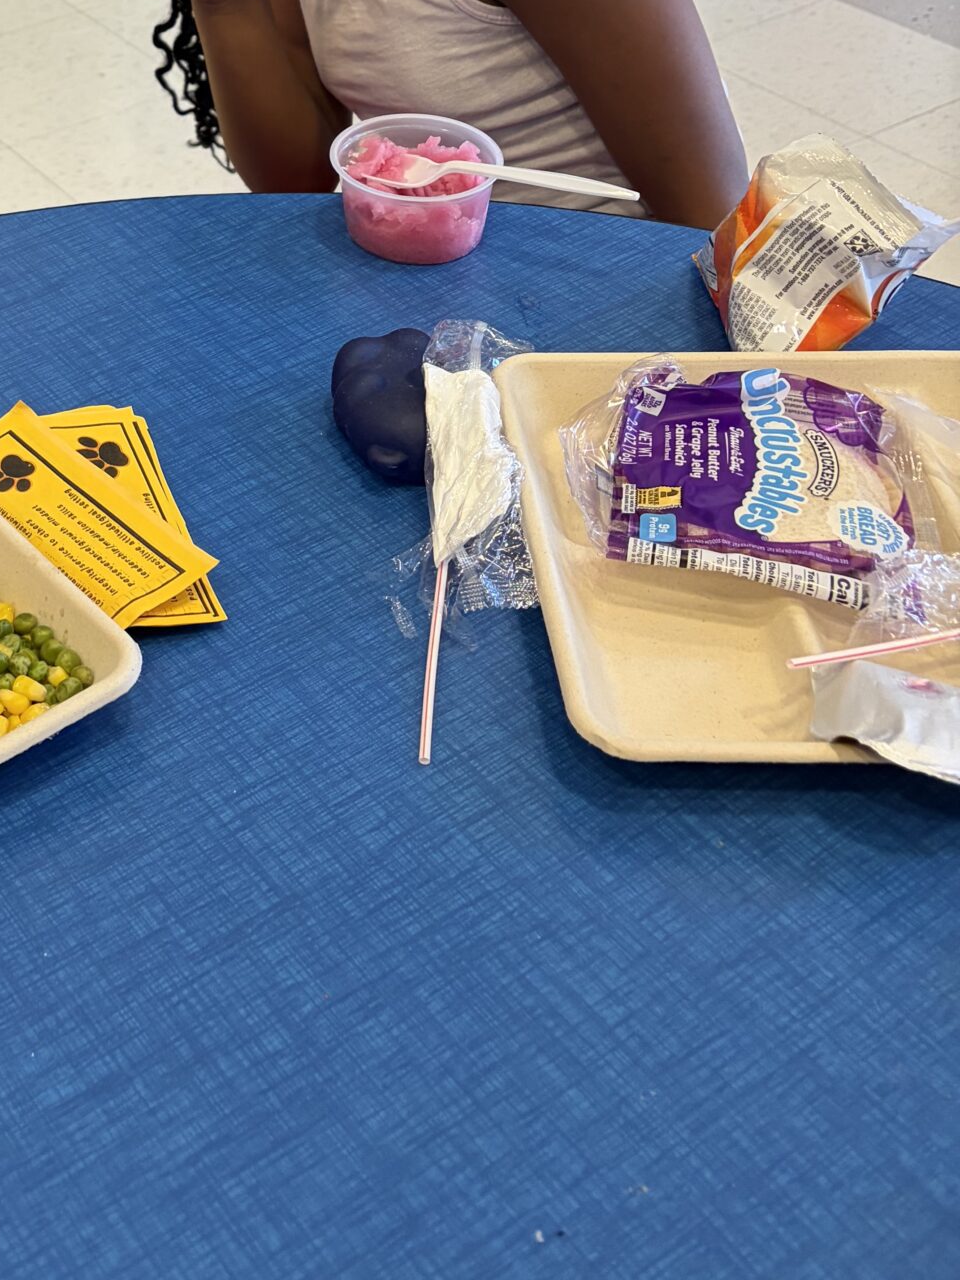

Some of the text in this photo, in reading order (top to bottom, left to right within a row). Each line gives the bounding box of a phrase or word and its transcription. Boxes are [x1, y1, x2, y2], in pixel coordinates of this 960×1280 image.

[625, 415, 638, 433] 2.6
[664, 424, 670, 432] on
[622, 431, 637, 447] OZ
[635, 429, 653, 457] NET WT
[674, 424, 687, 466] Sandwich
[687, 427, 704, 456] Grape
[707, 418, 720, 481] Peanut Butter
[740, 369, 807, 535] Uncrustables
[689, 458, 704, 478] Jelly
[64, 488, 166, 570] positive attitude/goal setting
[648, 516, 659, 539] Protein
[658, 523, 670, 533] 9g
[857, 506, 877, 546] BREAD
[32, 504, 134, 587] perseverance/growth mindset
[57, 504, 149, 578] leadership/mediation skills
[26, 519, 117, 596] integrity/service to others
[764, 561, 779, 586] Chole
